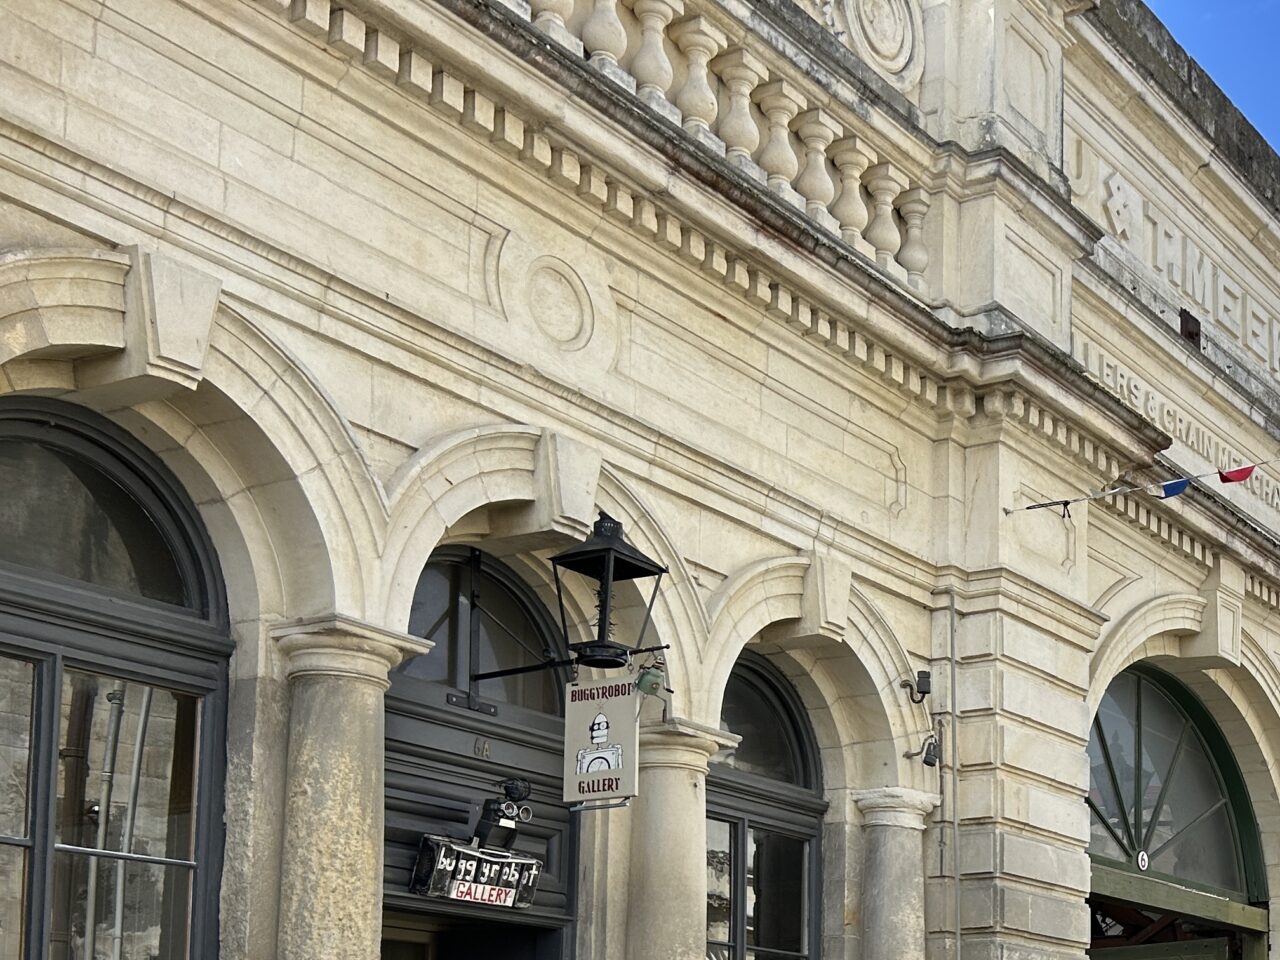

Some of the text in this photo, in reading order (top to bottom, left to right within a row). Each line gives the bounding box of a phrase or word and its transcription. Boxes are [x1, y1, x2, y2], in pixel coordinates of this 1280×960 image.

[1103, 171, 1136, 241] &
[1143, 390, 1159, 424] &
[1159, 402, 1213, 464] GRAIN
[570, 682, 633, 703] BUGGYROBOT
[578, 777, 621, 795] GALLERY
[1140, 852, 1147, 869] 6
[455, 882, 512, 905] GALLERY
